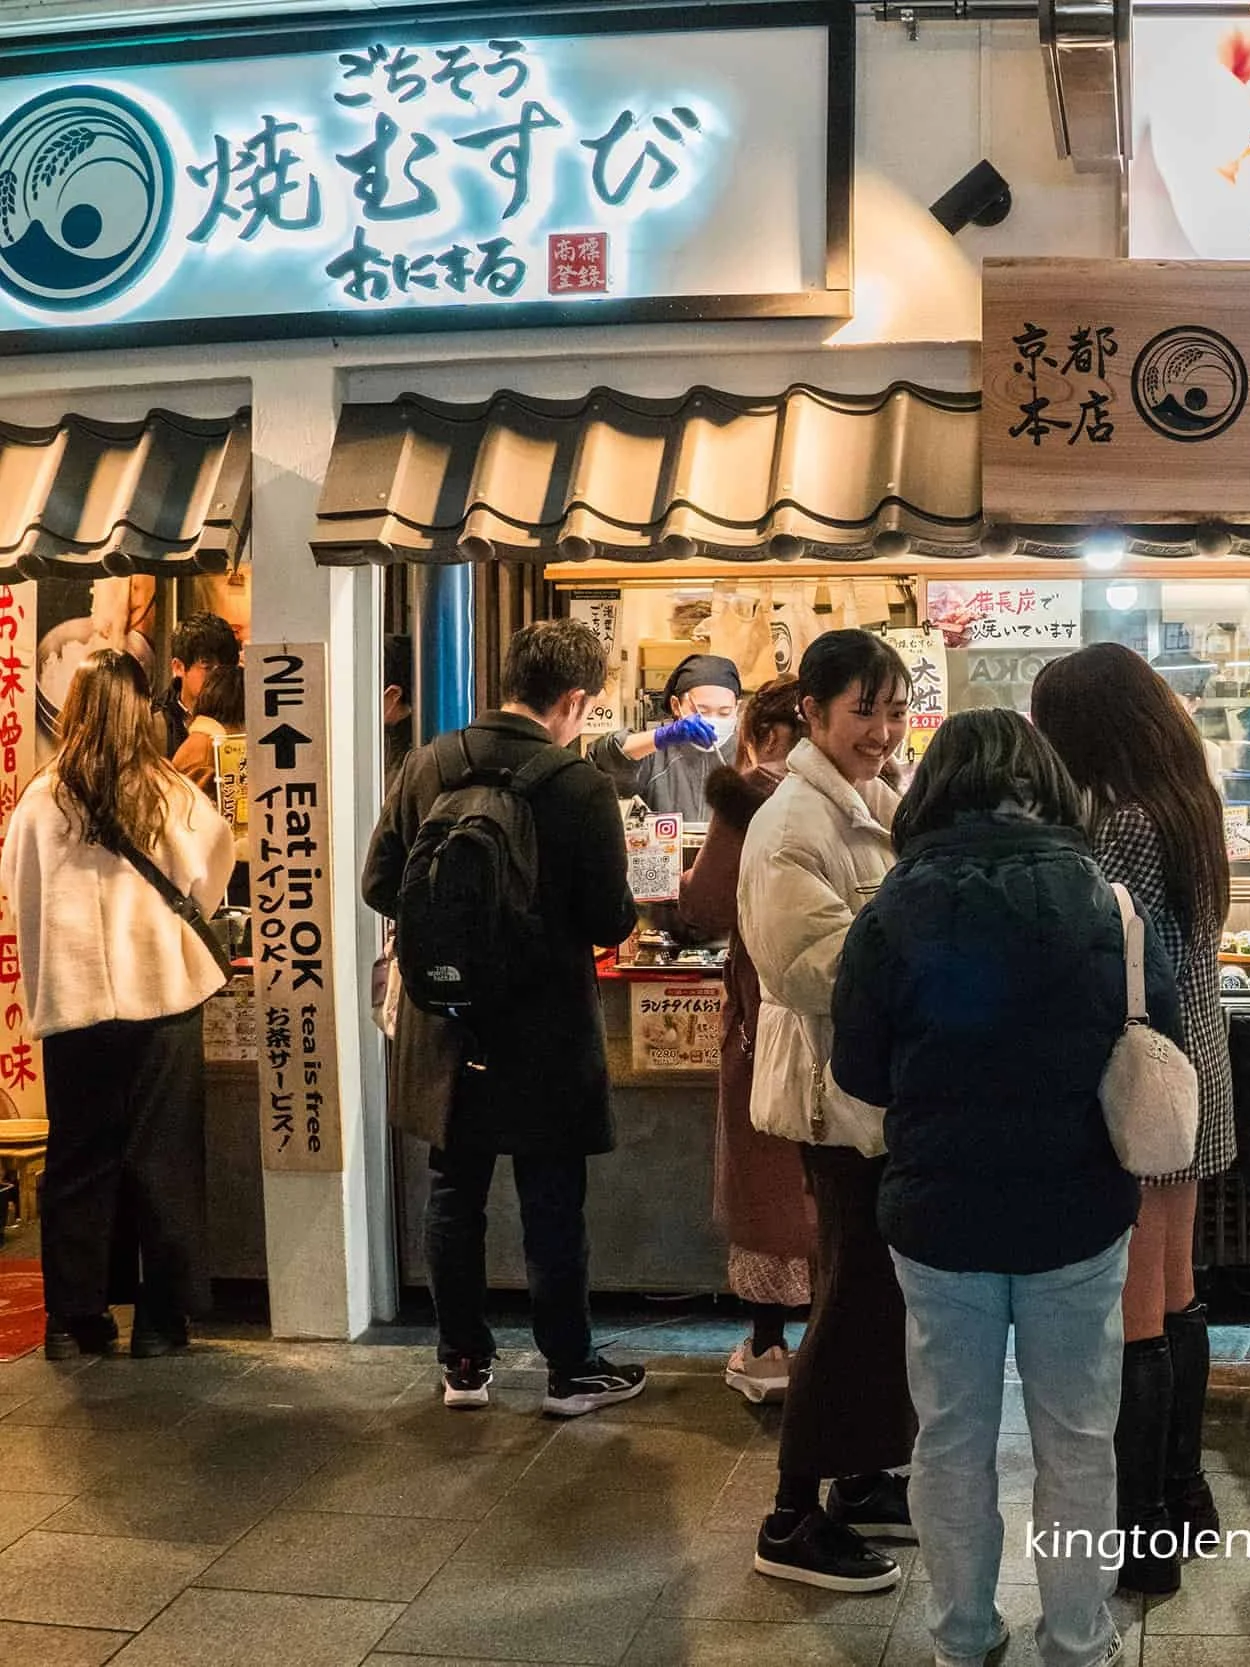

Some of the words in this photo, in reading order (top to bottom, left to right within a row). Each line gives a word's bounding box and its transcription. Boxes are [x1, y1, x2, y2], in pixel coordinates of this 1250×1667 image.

[334, 40, 530, 107] ごちそう
[186, 101, 702, 244] 焼むすび
[326, 226, 527, 301] おにまる
[1012, 322, 1118, 381] 京都
[1008, 386, 1115, 447] 本店
[966, 587, 1062, 615] 備長炭で
[972, 620, 1077, 641] 焼いています
[263, 655, 305, 718] 2F
[911, 656, 943, 712] 大粒
[286, 782, 318, 858] Eat
[288, 867, 322, 910] in
[290, 920, 324, 990] OK
[301, 1003, 317, 1053] tea
[304, 1061, 322, 1085] is
[305, 1090, 324, 1153] free
